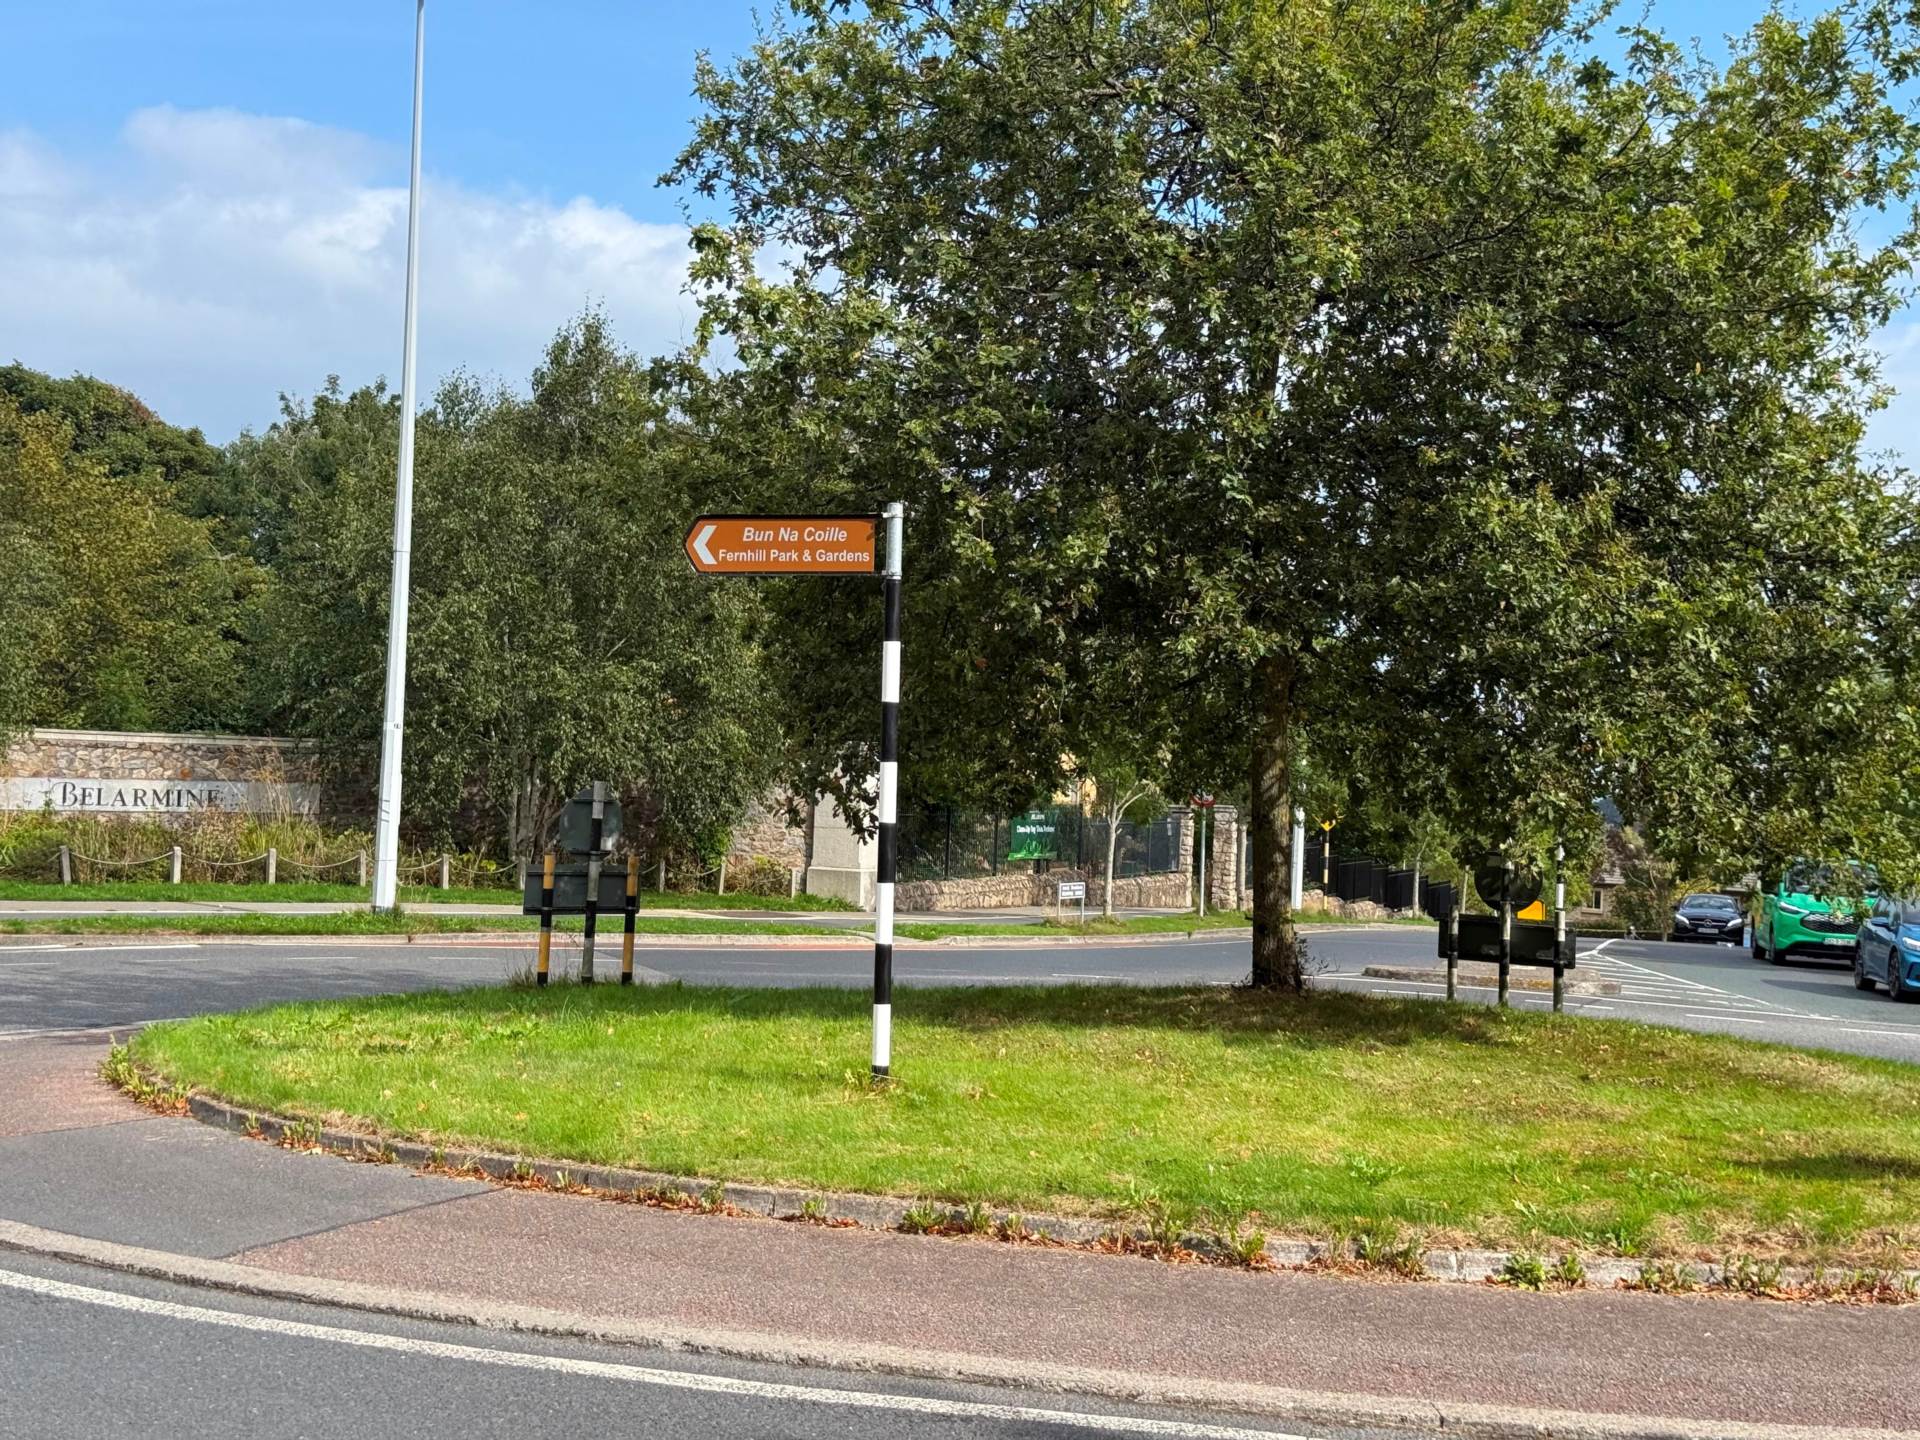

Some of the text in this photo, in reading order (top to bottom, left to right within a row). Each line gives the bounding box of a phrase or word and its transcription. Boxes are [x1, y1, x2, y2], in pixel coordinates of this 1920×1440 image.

[743, 527, 847, 541] Bun Na Coille
[719, 549, 871, 562] Fernhill Park & Gardens
